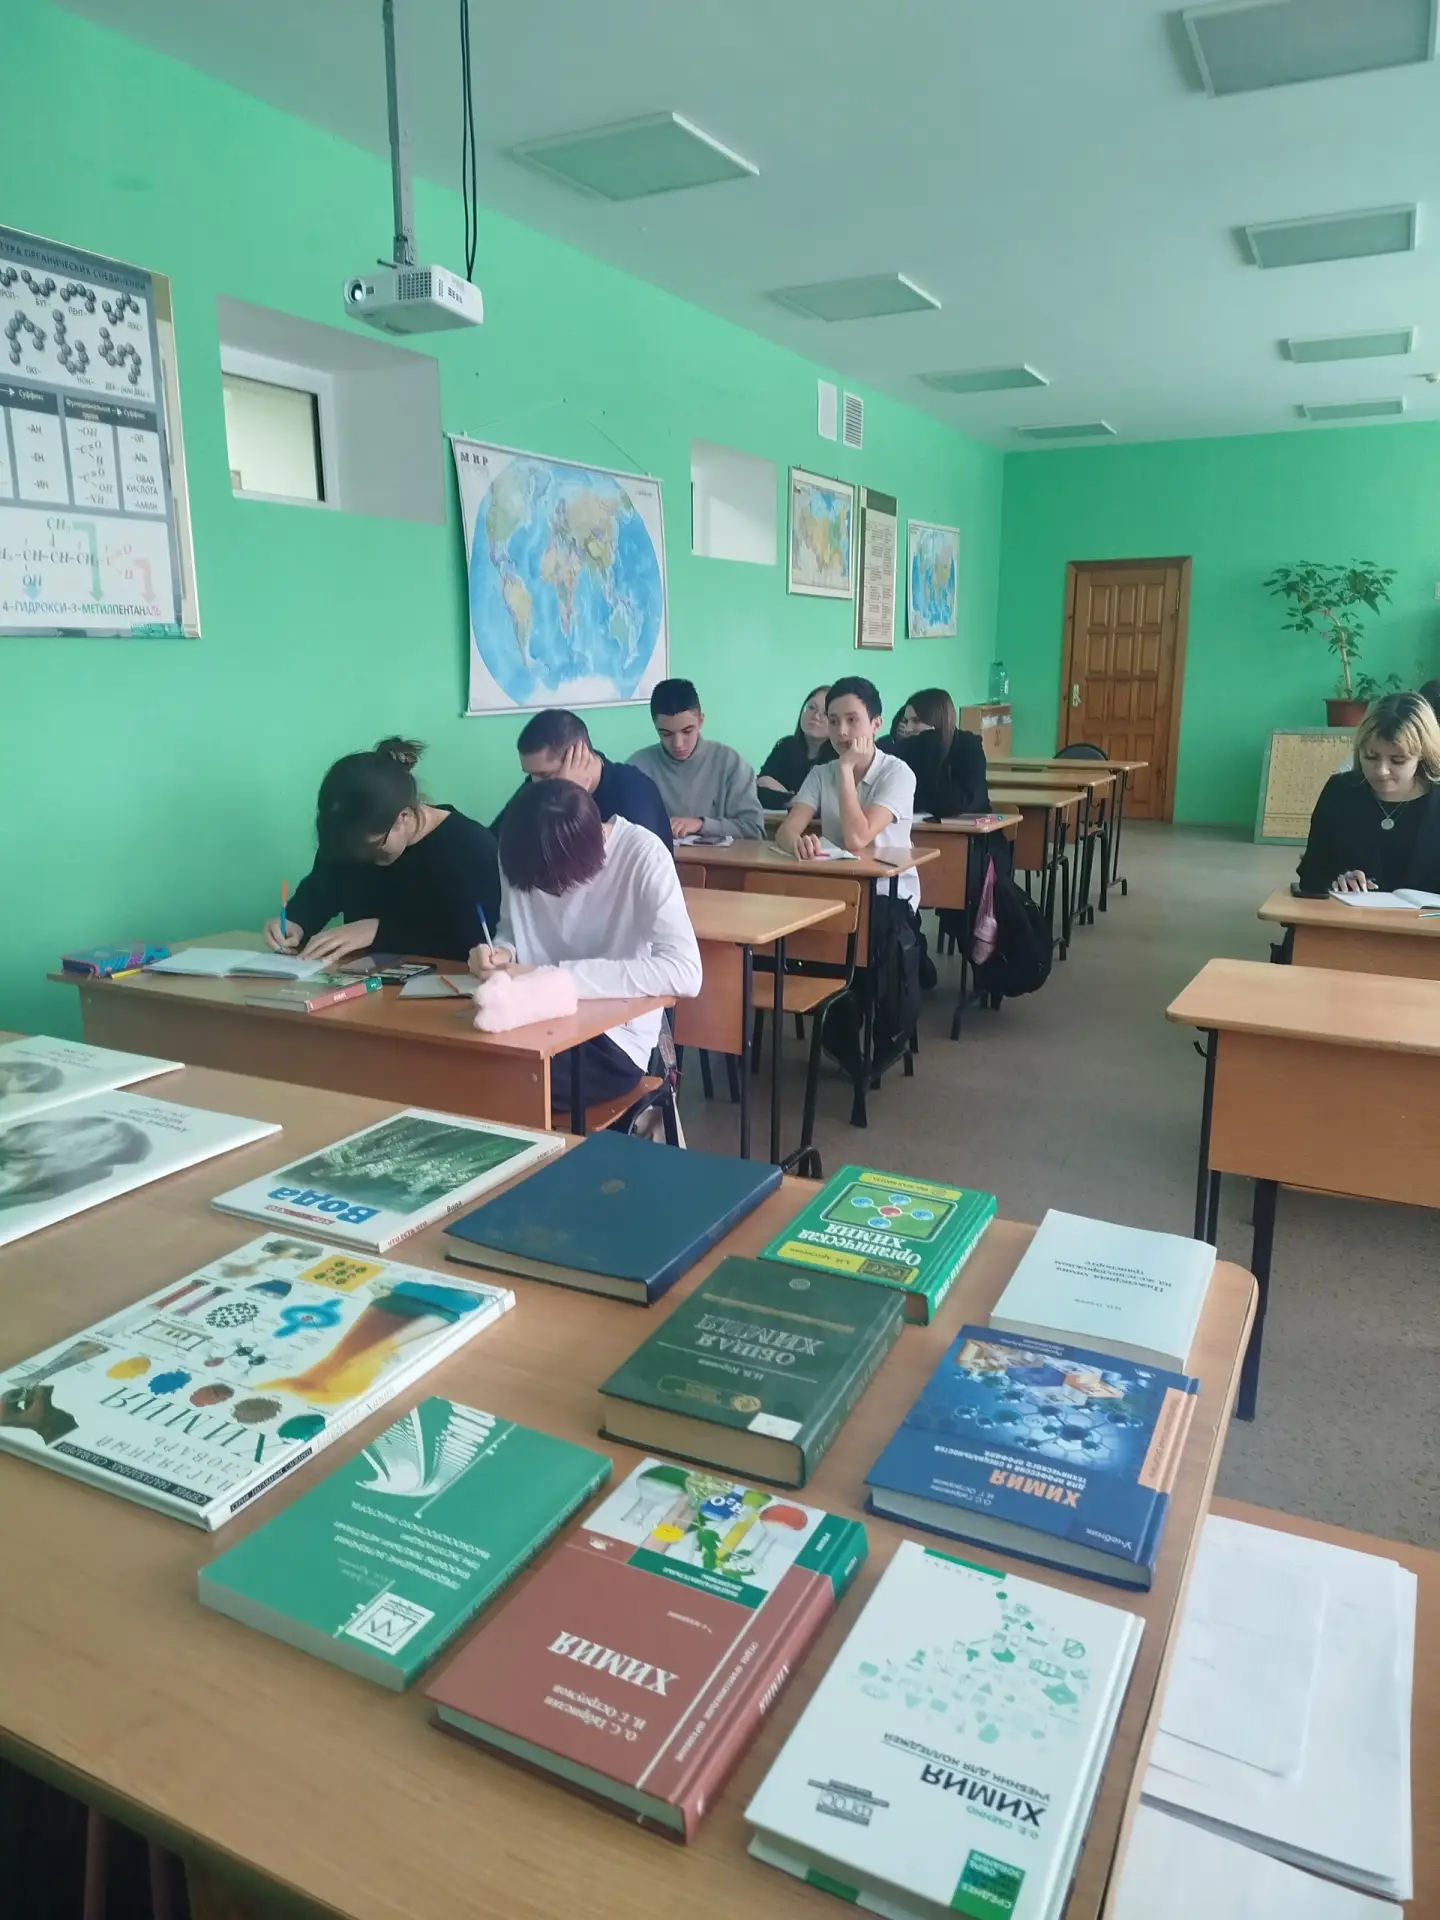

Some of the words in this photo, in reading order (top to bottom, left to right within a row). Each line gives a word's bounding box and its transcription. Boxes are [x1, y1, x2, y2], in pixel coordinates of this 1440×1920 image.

[126, 484, 158, 496] КИСЛОТА
[268, 1187, 381, 1224] Вода
[446, 1200, 462, 1213] Вода
[797, 1228, 922, 1266] Органическая
[694, 1313, 824, 1356] ХИМИЯ
[695, 1332, 796, 1366] ОБЩАЯ
[98, 1386, 290, 1465] ХИМИЯ
[95, 1435, 236, 1492] НАГЛЯДНЫЙ
[153, 1436, 253, 1478] СЛОВАРЬ
[933, 1444, 1004, 1469] СПЕЦИАЛЬНОСТЕЙ
[1026, 1460, 1087, 1483] ТЕХНИЧЕСКОГО
[988, 1470, 1082, 1509] ХИМИЯ
[1014, 1465, 1065, 1486] ПРОФЕССИЙ
[1066, 1480, 1086, 1490] ДЛЯ
[176, 1485, 209, 1505] СЕРИЯ
[1084, 1527, 1133, 1551] Учебник
[546, 1630, 680, 1696] ХИМИЯ
[884, 1732, 960, 1766] КОЛЛЕДЖЕЙ
[962, 1762, 990, 1779] ДЛЯ
[920, 1764, 1046, 1828] ХИМИЯ
[992, 1773, 1050, 1802] УЧЕБНИК
[961, 1882, 1012, 1909] СРЕДНЕЕ
